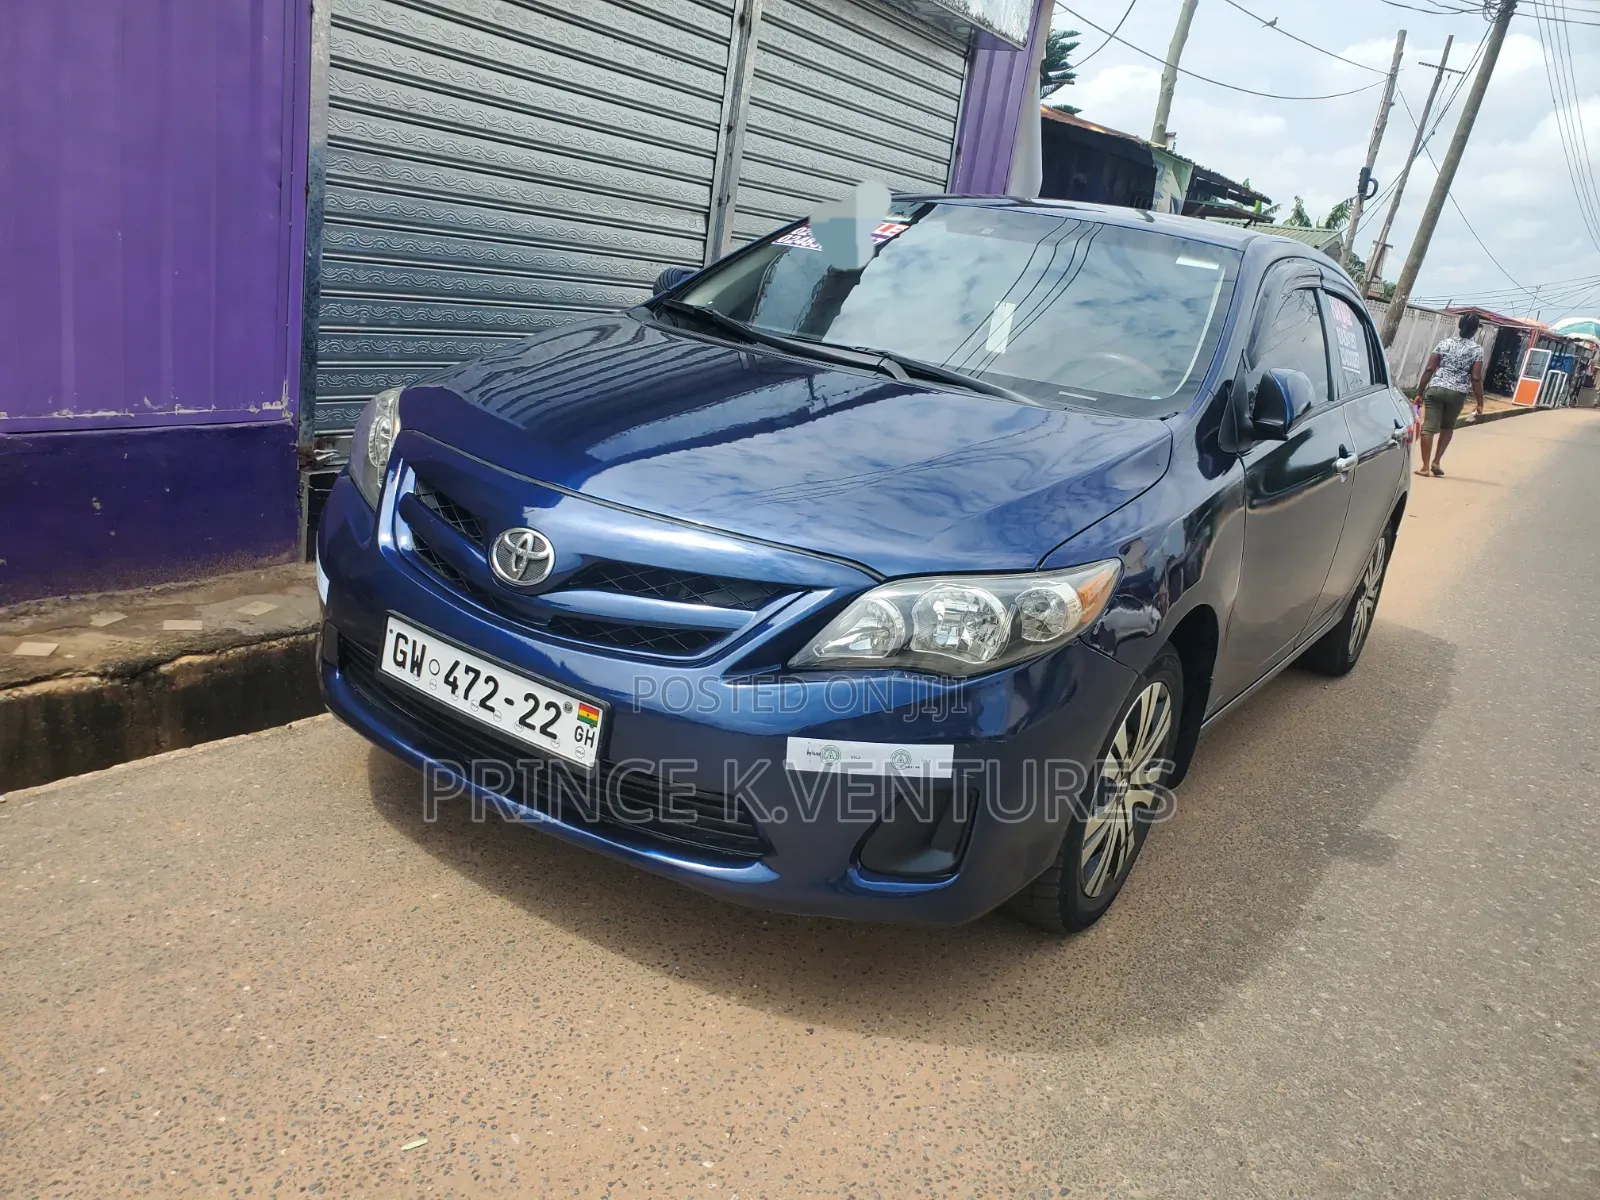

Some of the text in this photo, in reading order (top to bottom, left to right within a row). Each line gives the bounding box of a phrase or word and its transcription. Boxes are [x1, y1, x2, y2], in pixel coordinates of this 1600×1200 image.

[392, 631, 562, 740] GW 472-22
[574, 724, 595, 748] GH
